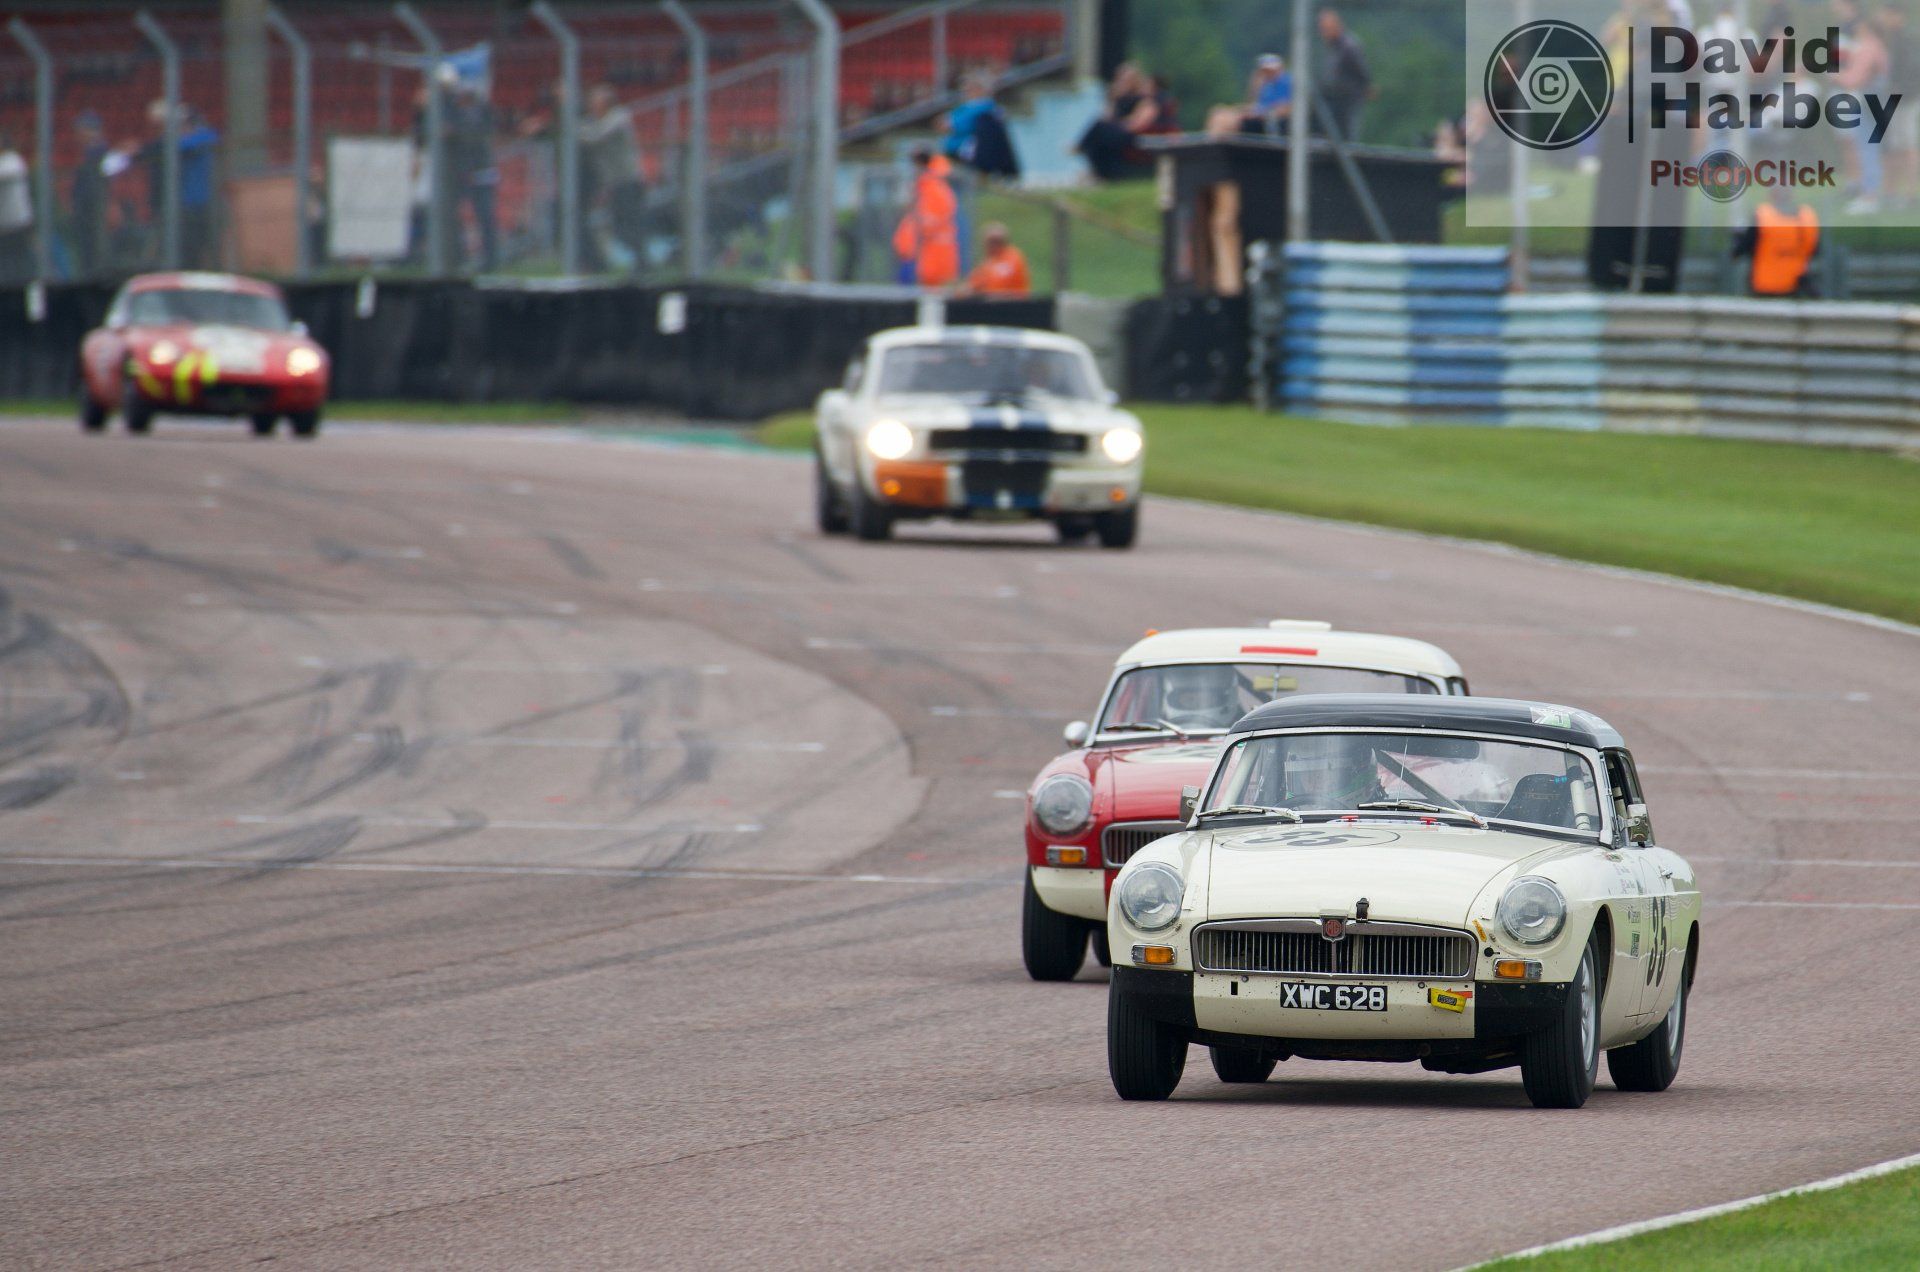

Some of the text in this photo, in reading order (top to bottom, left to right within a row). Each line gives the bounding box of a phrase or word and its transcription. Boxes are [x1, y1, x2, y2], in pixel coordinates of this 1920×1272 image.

[1244, 830, 1374, 847] 35
[1327, 920, 1341, 936] MG
[1646, 896, 1668, 988] 35
[1282, 983, 1385, 1011] XWC 628
